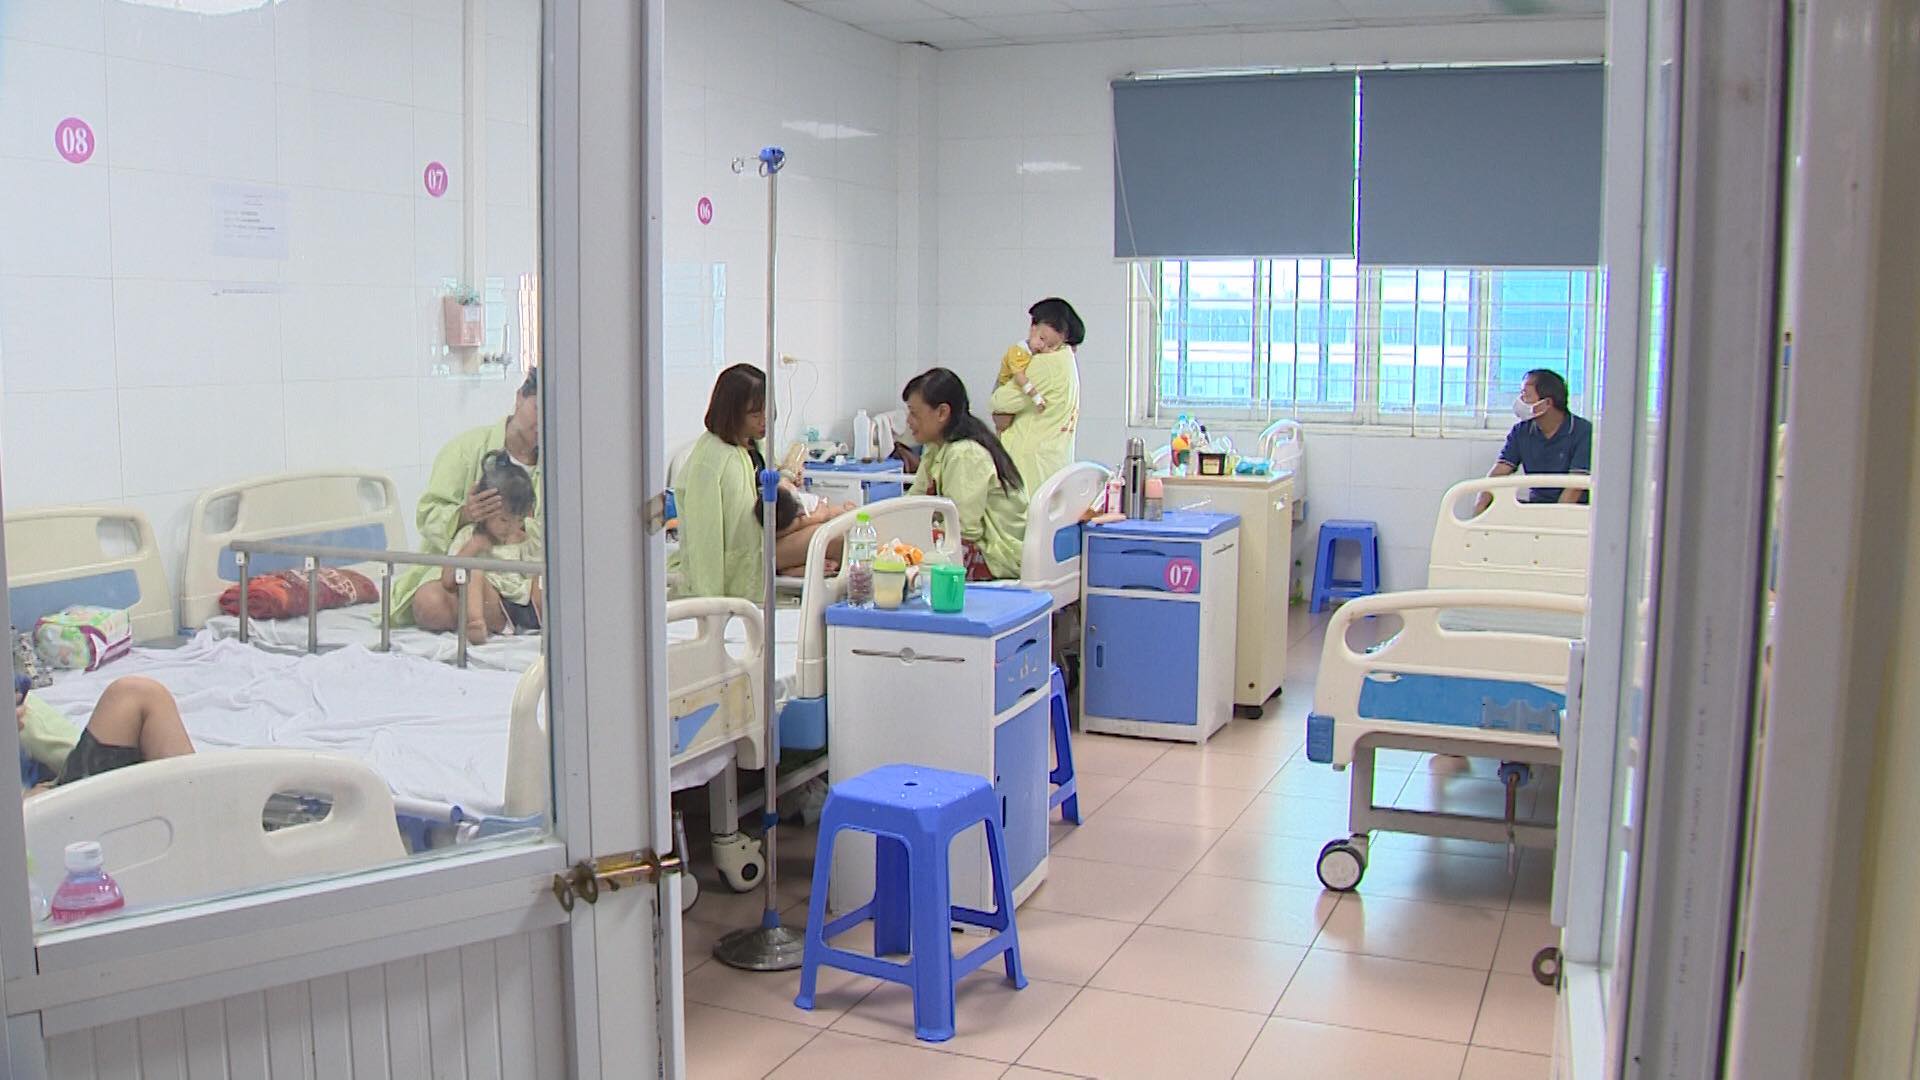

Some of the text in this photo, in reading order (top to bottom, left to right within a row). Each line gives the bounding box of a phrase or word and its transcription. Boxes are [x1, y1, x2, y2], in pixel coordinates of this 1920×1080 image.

[62, 126, 88, 154] 08
[427, 168, 444, 190] 07
[699, 203, 711, 219] 06
[1170, 564, 1192, 587] 07
